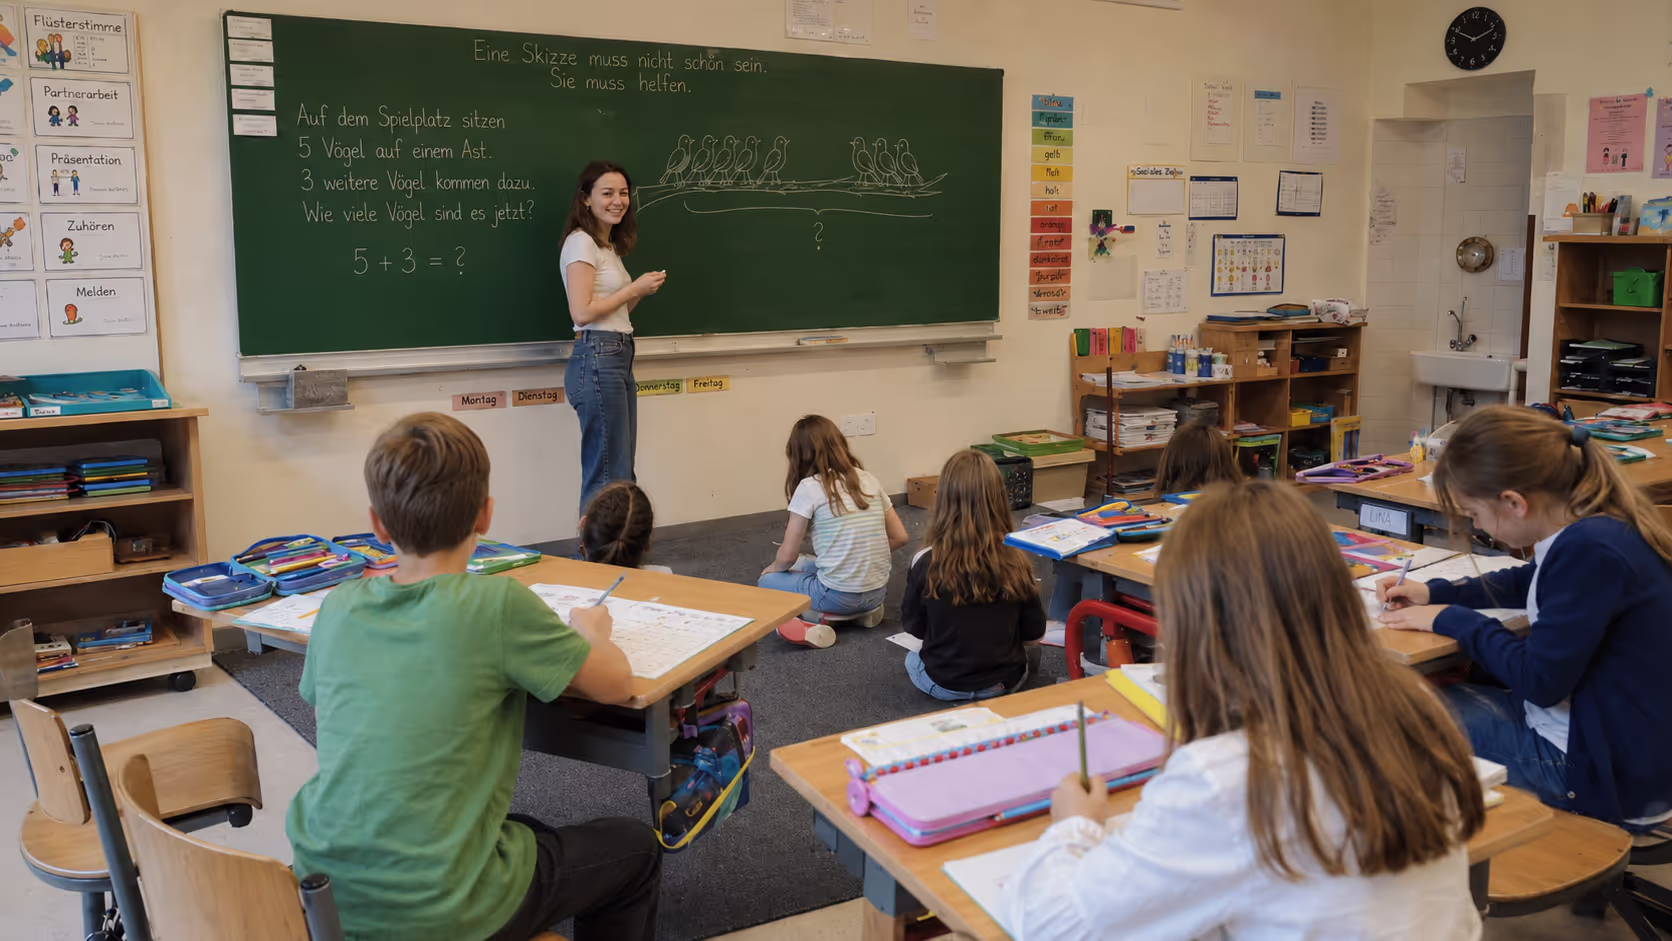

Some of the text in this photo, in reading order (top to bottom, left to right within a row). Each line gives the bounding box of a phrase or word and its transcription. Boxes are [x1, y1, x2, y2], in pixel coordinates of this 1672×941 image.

[1472, 11, 1480, 19] 12
[34, 14, 122, 33] Flüsterstimme
[474, 39, 767, 73] Eine Skizze muss nicht schön sein.
[550, 67, 692, 93] Sie muss helfen.
[43, 85, 118, 101] Partnerarbeit
[297, 103, 329, 127] Auf
[338, 105, 369, 127] dem
[378, 104, 452, 134] Spielplatz
[462, 109, 506, 129] sitzen
[51, 152, 122, 166] Präsentation
[299, 136, 492, 167] 5 Vögel auf einem Ast.
[1044, 148, 1061, 161] gelb
[301, 168, 535, 198] 3 weitere Vögel kommen dazu.
[303, 199, 535, 229] Wie viele Vögel sind es jetzt?
[67, 219, 115, 232] Zuhören
[813, 221, 824, 251] ?
[353, 246, 466, 275] 5 + 3 = ?
[76, 285, 116, 298] Melden
[634, 381, 680, 392] Donnerstag
[693, 378, 723, 389] Freitag
[461, 395, 497, 407] Montag
[518, 391, 557, 402] Dienstag
[1370, 510, 1392, 527] LINA
